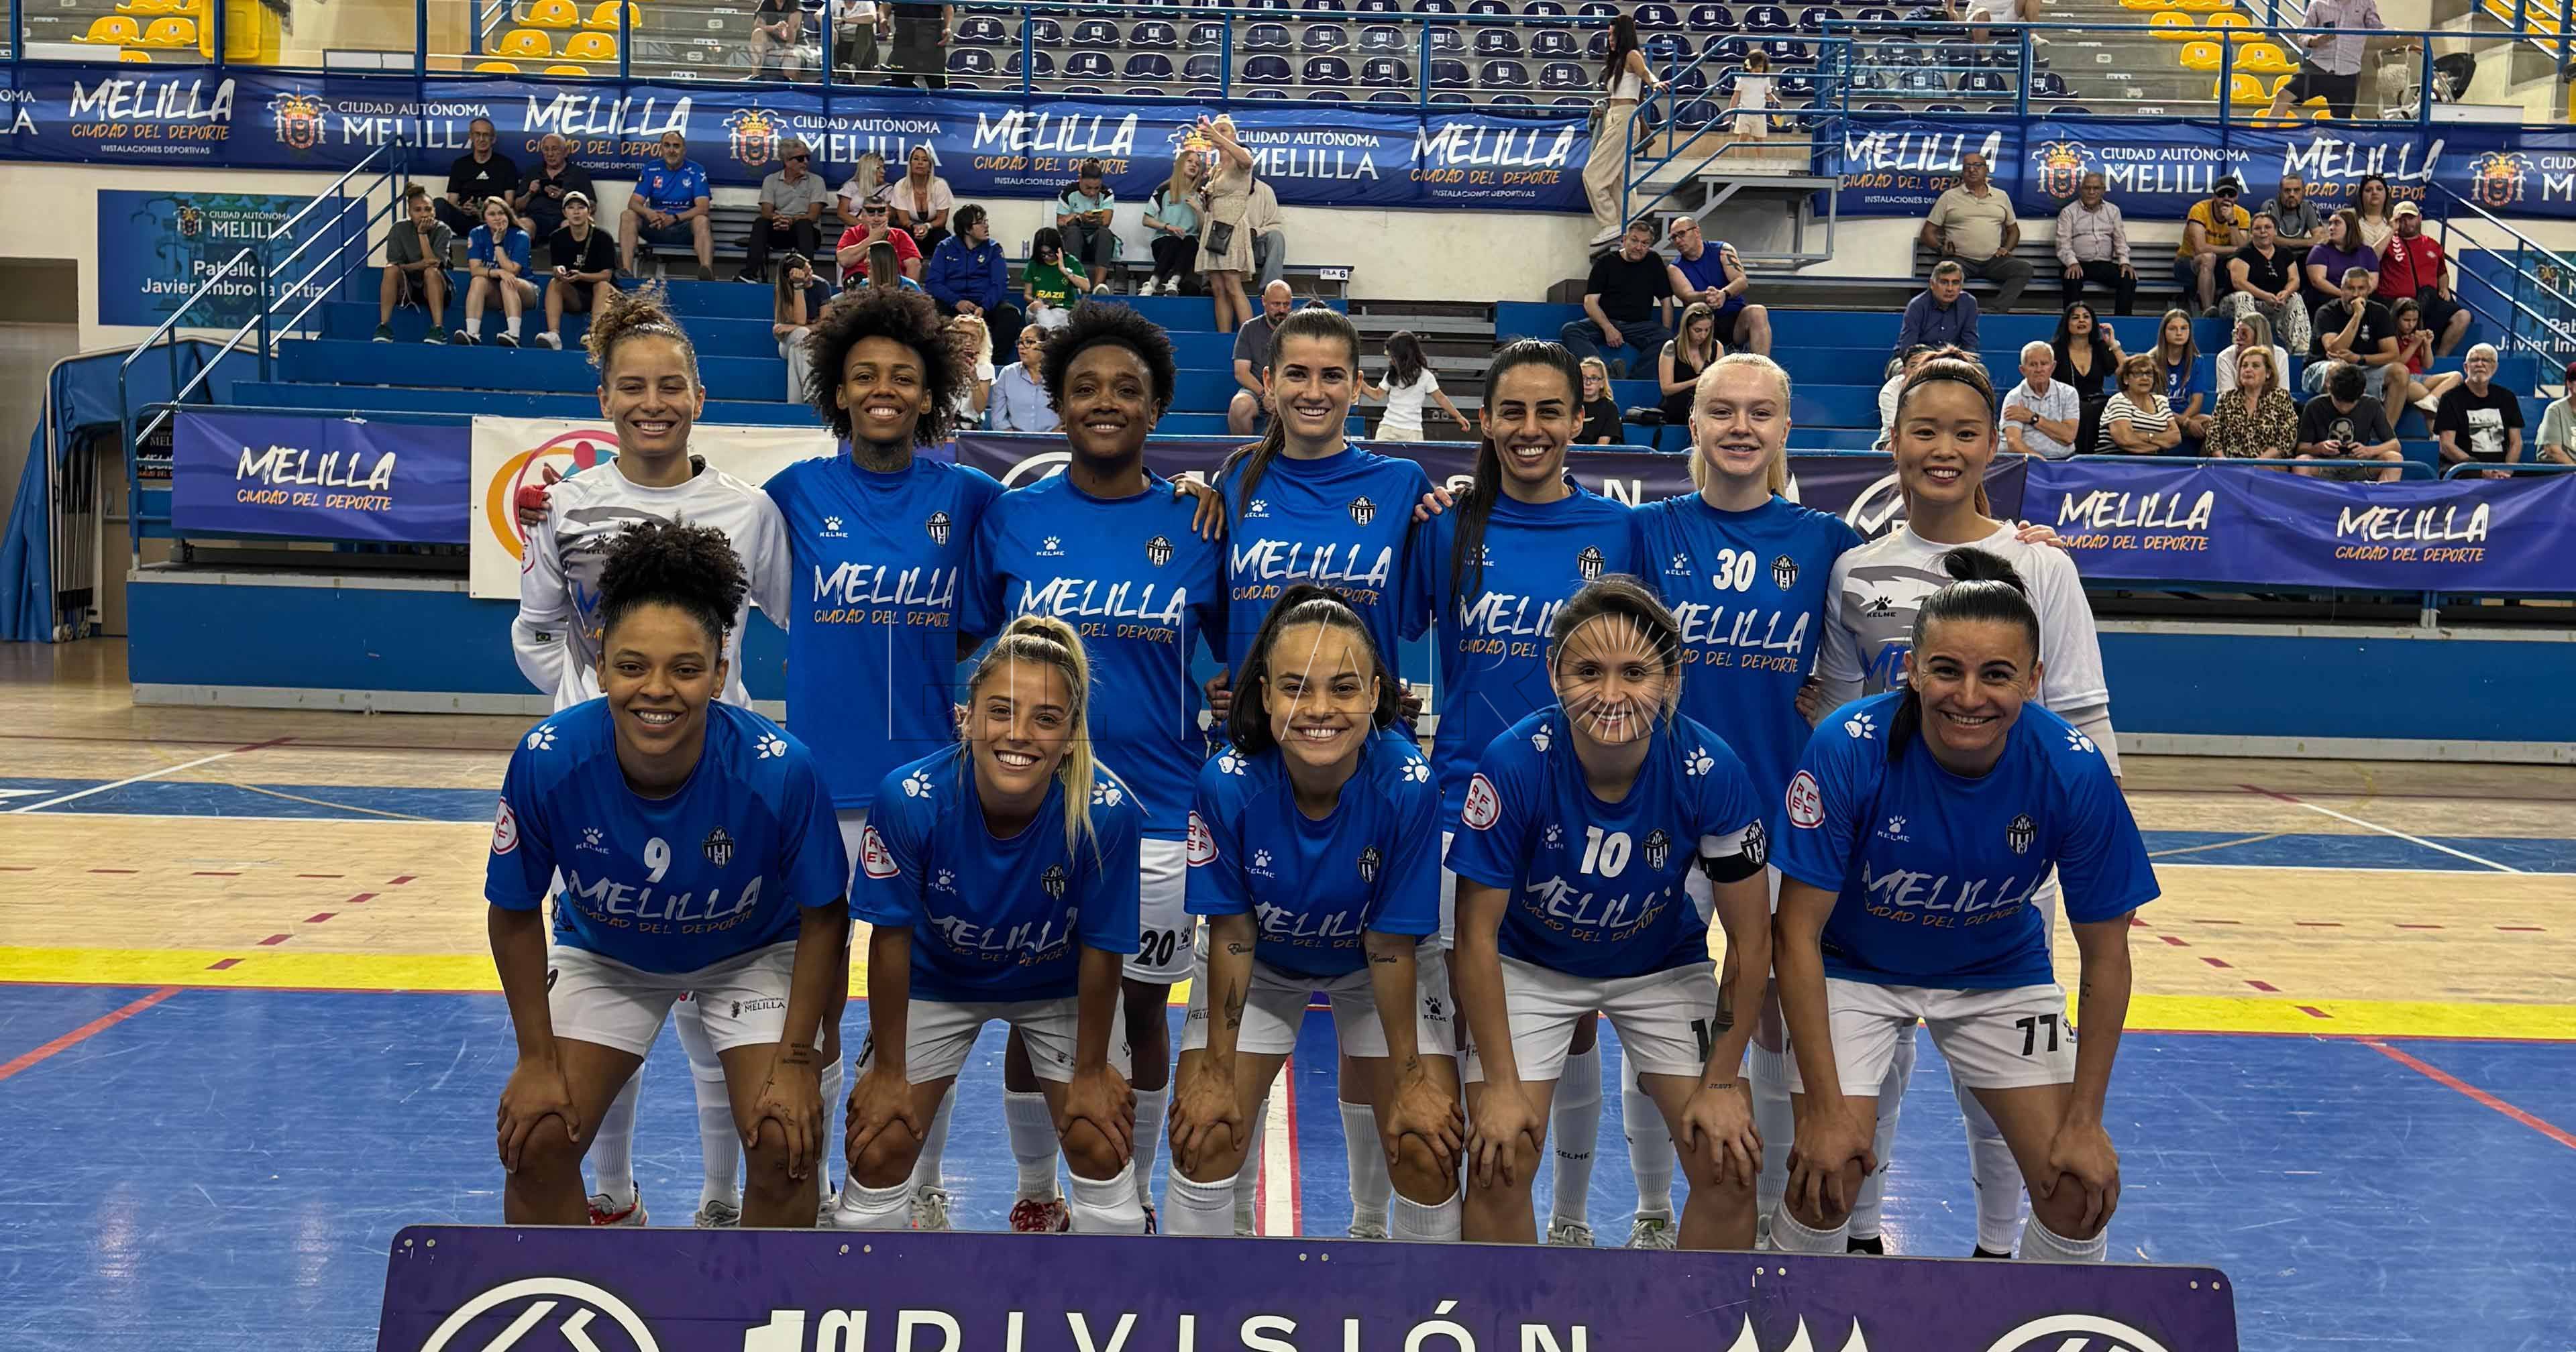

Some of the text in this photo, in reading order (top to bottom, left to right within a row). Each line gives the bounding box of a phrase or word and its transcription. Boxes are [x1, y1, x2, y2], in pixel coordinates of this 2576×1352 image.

[69, 78, 235, 122] MELILLA
[338, 101, 490, 117] CIUDAD AUTÓNOMA
[524, 92, 692, 137] MELILLA
[70, 123, 230, 142] CIUDAD DEL DEPORTE
[794, 115, 941, 133] CIUDAD AUTÓNOMA
[973, 109, 1138, 156] MELILLA
[587, 139, 613, 156] DEL
[1236, 130, 1380, 148] CIUDAD AUTÓNOMA
[1411, 122, 1576, 168] MELILLA
[101, 144, 210, 155] INSTALACIONES DEPORTIVAS
[1844, 130, 2002, 174] MELILLA
[2101, 146, 2251, 162] CIUDAD AUTÓNOMA
[974, 156, 1028, 170] CIUDAD
[1034, 158, 1062, 172] DEL
[2282, 136, 2445, 183] MELILLA
[994, 177, 1054, 186] INSTALACIONES
[1411, 168, 1560, 186] CIUDAD DEL DEPORTE
[1898, 176, 1924, 190] DEL
[1432, 188, 1536, 199] INSTALACIONES DEPORTIVAS
[1864, 195, 1923, 205] INSTALACIONES
[1339, 270, 1346, 278] 6
[141, 277, 195, 294] Javier
[2169, 373, 2177, 386] 3
[235, 445, 396, 492] MELILLA
[237, 488, 392, 512] CIUDAD DEL DEPORTE
[2057, 489, 2214, 531] MELILLA
[2336, 502, 2490, 543] MELILLA
[2113, 534, 2138, 551] DEL
[2144, 536, 2209, 552] DEPORTE
[1230, 538, 1392, 588] MELILLA
[2335, 545, 2485, 563] CIUDAD DEL DEPORTE
[1712, 548, 1757, 592] 30
[813, 561, 958, 609] MELILLA
[1232, 585, 1280, 601] CIUDAD
[1018, 575, 1187, 624] MELILLA
[814, 609, 865, 624] CIUDAD
[871, 610, 899, 626] DEL
[1866, 610, 1897, 618] KELME
[1080, 622, 1176, 644] DEL DEPORTE
[1511, 640, 1539, 658] DEL
[1705, 650, 1733, 668] DEL
[1741, 653, 1799, 674] DEPORTE
[643, 837, 671, 884] 9
[1579, 825, 1631, 878] 10
[569, 869, 763, 922] MELILLA
[639, 921, 672, 935] DEL
[1922, 915, 1955, 929] DEL
[1570, 927, 1601, 943] DEL
[1134, 929, 1175, 967] 20
[744, 1001, 786, 1013] MELILLA
[2015, 1013, 2059, 1056] 77
